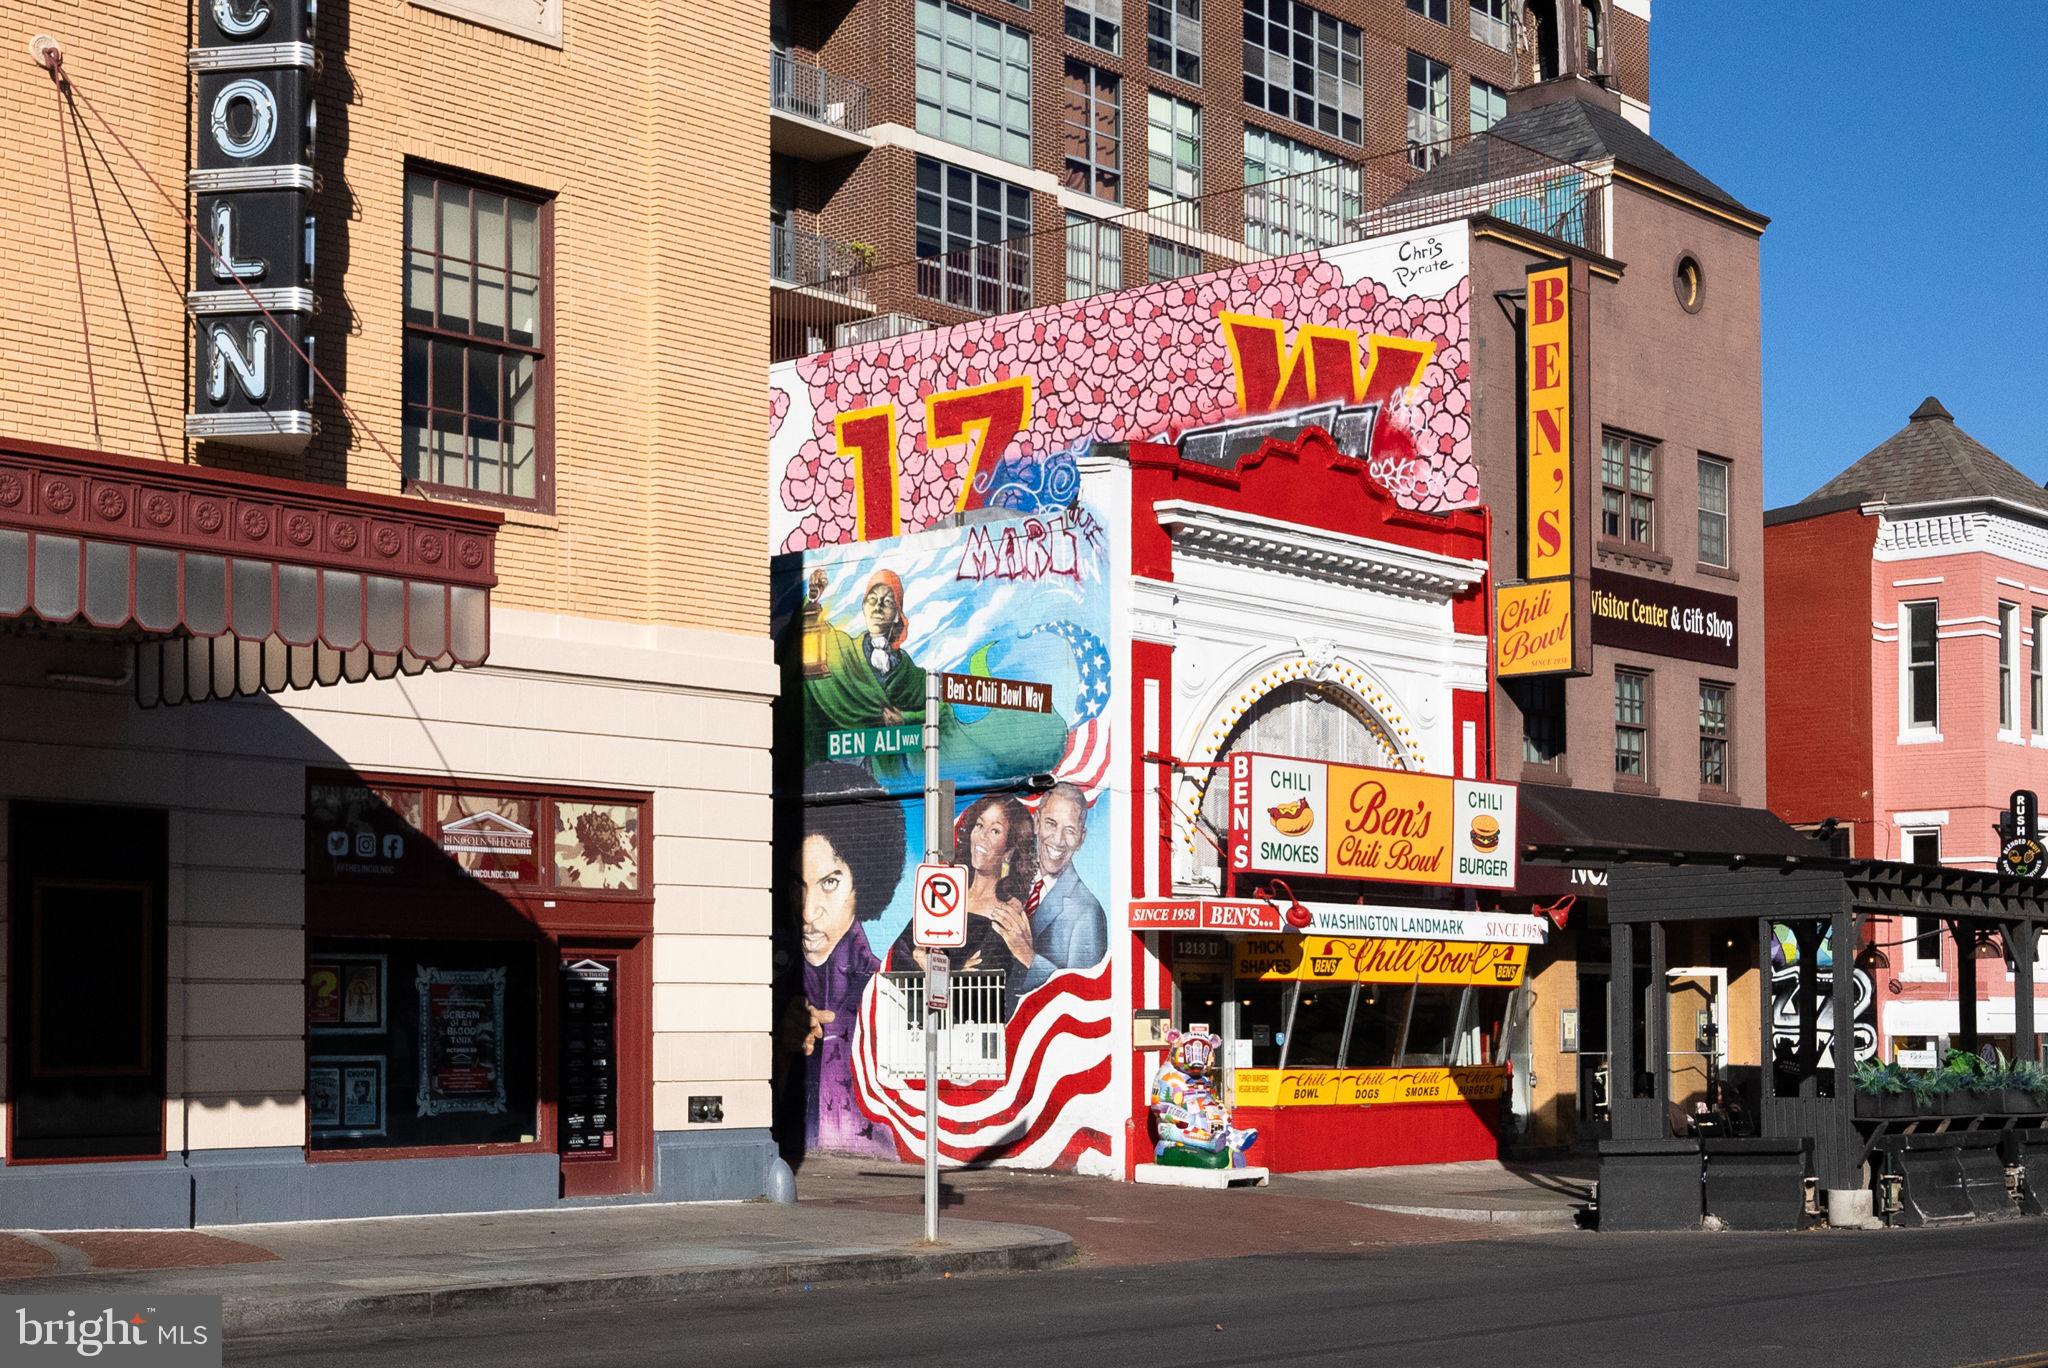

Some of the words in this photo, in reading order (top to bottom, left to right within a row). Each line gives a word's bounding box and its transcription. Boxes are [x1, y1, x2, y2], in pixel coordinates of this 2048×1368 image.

[1398, 237, 1443, 262] Chris
[1531, 277, 1565, 559] BEN'S
[1500, 589, 1552, 633] Chili
[1591, 590, 1630, 620] Visitor
[1631, 598, 1668, 628] Center
[1670, 606, 1681, 631] &
[1683, 609, 1705, 635] Gift
[1706, 613, 1733, 647] Shop
[1500, 612, 1569, 667] Bowl
[947, 677, 973, 700] Ben's
[975, 681, 998, 704] Chili
[1001, 683, 1023, 707] Bowl
[1025, 685, 1044, 713] Way
[830, 731, 866, 756] BEN
[874, 729, 901, 753] ALI
[901, 734, 920, 747] WAY
[1270, 770, 1311, 792] CHILI
[1345, 781, 1432, 838] Ben's
[1468, 791, 1503, 811] CHILI
[1233, 755, 1249, 869] BEN'S
[2016, 795, 2026, 836] RUSH
[444, 834, 488, 847] LINCOLN
[490, 835, 532, 848] THEATRE
[1261, 842, 1319, 864] SMOKES
[1336, 835, 1382, 868] Chili
[1385, 839, 1444, 873] Bowl
[1459, 857, 1508, 877] BURGER
[1132, 908, 1169, 921] SINCE
[1171, 908, 1196, 921] 1958
[1319, 914, 1399, 932] WASHINGTON
[1401, 917, 1465, 935] LANDMARK
[1486, 922, 1520, 937] SINCE
[1521, 923, 1543, 938] 1958
[1178, 942, 1206, 955] 1213
[1247, 940, 1285, 954] THICK
[1354, 938, 1417, 974] Chili
[1420, 940, 1496, 974] Bowl
[1240, 959, 1292, 974] SHAKES
[1296, 1072, 1327, 1087] Chili
[1356, 1071, 1386, 1086] Chili
[1412, 1071, 1440, 1084] Chili
[1465, 1070, 1492, 1083] Chili
[1294, 1089, 1319, 1099] BOWL
[1355, 1088, 1379, 1099] DOGS
[1405, 1086, 1440, 1097] SMOKES
[1457, 1084, 1495, 1095] BURGERS
